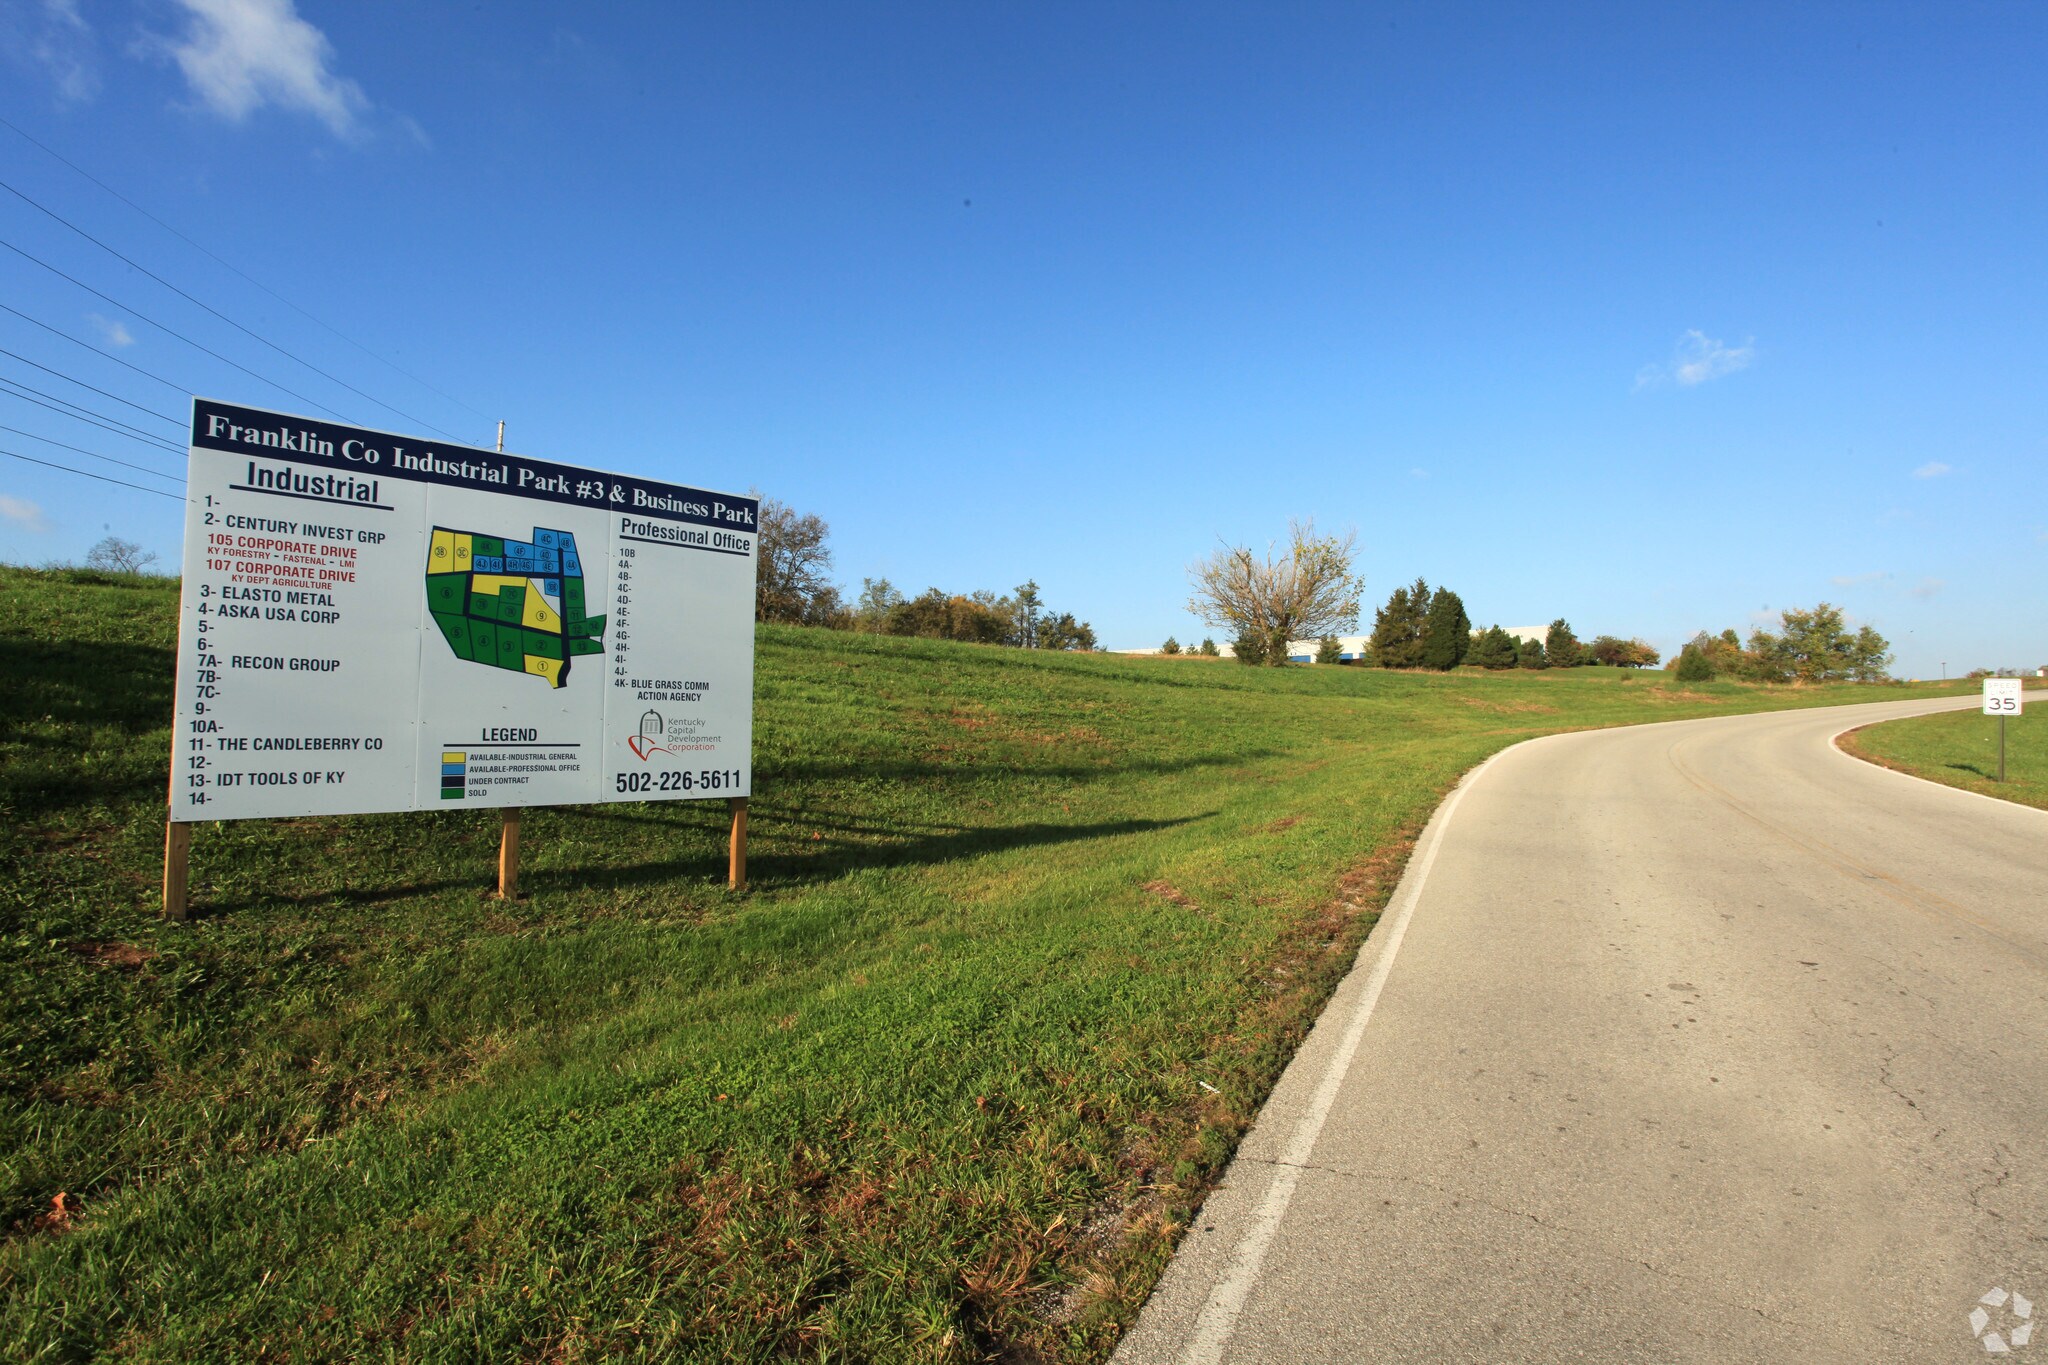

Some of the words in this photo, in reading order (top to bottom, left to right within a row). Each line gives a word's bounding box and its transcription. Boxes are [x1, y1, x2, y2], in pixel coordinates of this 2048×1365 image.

[206, 414, 334, 457] Franklin
[342, 439, 380, 464] Co
[392, 447, 508, 485] Industrial
[517, 467, 570, 495] Park
[576, 480, 604, 500] #3
[609, 484, 625, 503] &
[632, 488, 708, 517] Business
[713, 502, 754, 525] Park
[248, 461, 378, 503] Industrial
[205, 495, 220, 507] 1-
[204, 512, 220, 525] 2-
[226, 514, 298, 534] CENTURY
[303, 524, 354, 541] INVEST
[358, 530, 386, 544] GRP
[621, 517, 709, 546] Professional
[715, 531, 750, 551] Office
[208, 533, 233, 546] 105
[237, 536, 316, 555] CORPORATE
[321, 545, 357, 559] DRIVE
[207, 546, 221, 555] KY
[223, 548, 271, 560] FORESTRY
[283, 554, 327, 566] FASTENAL
[339, 559, 355, 568] LMI
[620, 548, 636, 558] 10B
[618, 560, 633, 569] 4A-
[206, 559, 231, 571] 107
[236, 561, 315, 579] CORPORATE
[319, 569, 356, 583] DRIVE
[618, 571, 632, 581] 4B-
[231, 574, 245, 583] KY
[246, 575, 270, 585] DEPT
[272, 578, 332, 590] AGRICULTURE
[617, 583, 632, 593] 4C-
[200, 584, 216, 597] 3-
[222, 586, 281, 602] ELASTO
[286, 591, 336, 607] METAL
[617, 595, 632, 605] 4D-
[198, 602, 214, 615] 4-
[217, 604, 260, 619] ASKA
[265, 608, 296, 622] USA
[300, 610, 340, 624] CORP
[616, 607, 631, 617] 4E-
[198, 620, 214, 633] 5-
[616, 619, 630, 628] 4F-
[615, 631, 631, 640] 4G-
[197, 638, 213, 650] 6-
[615, 643, 630, 652] 4H-
[198, 654, 222, 667] 7A-
[231, 656, 284, 670] RECON
[289, 658, 340, 672] GROUP
[614, 655, 626, 664] 4I-
[196, 670, 221, 683] 7B-
[614, 667, 628, 676] 4J-
[614, 679, 629, 688] 4K-
[631, 679, 653, 689] BLUE
[655, 680, 683, 690] GRASS
[684, 681, 710, 691] COMM
[196, 685, 221, 699] 7C-
[637, 691, 668, 701] ACTION
[669, 692, 702, 702] AGENCY
[195, 702, 211, 715] 9-
[1988, 697, 2016, 711] 35
[189, 720, 224, 733] 10A-
[668, 718, 706, 727] Kentucky
[482, 727, 538, 742] LEGEND
[667, 726, 696, 735] Capital
[189, 738, 212, 750] 11-
[217, 738, 248, 751] THE
[253, 738, 360, 751] CANDLEBERRY
[364, 738, 383, 751] CO
[667, 735, 722, 744] Development
[667, 743, 715, 752] Corporation
[188, 756, 212, 769] 12-
[469, 753, 547, 761] AVAILABLE-INDUSTRIAL
[548, 753, 577, 761] GENERAL
[469, 765, 557, 773] AVAILABLE-PROFESSIONAL
[558, 764, 581, 772] OFFICE
[187, 774, 211, 787] 13-
[217, 773, 243, 787] IDT
[248, 772, 298, 786] TOOLS
[303, 771, 322, 784] OF
[326, 771, 345, 784] KY
[468, 777, 493, 785] UNDER
[616, 769, 740, 793] 502-226-5611
[189, 792, 212, 805] 14-
[468, 789, 487, 797] SOLD
